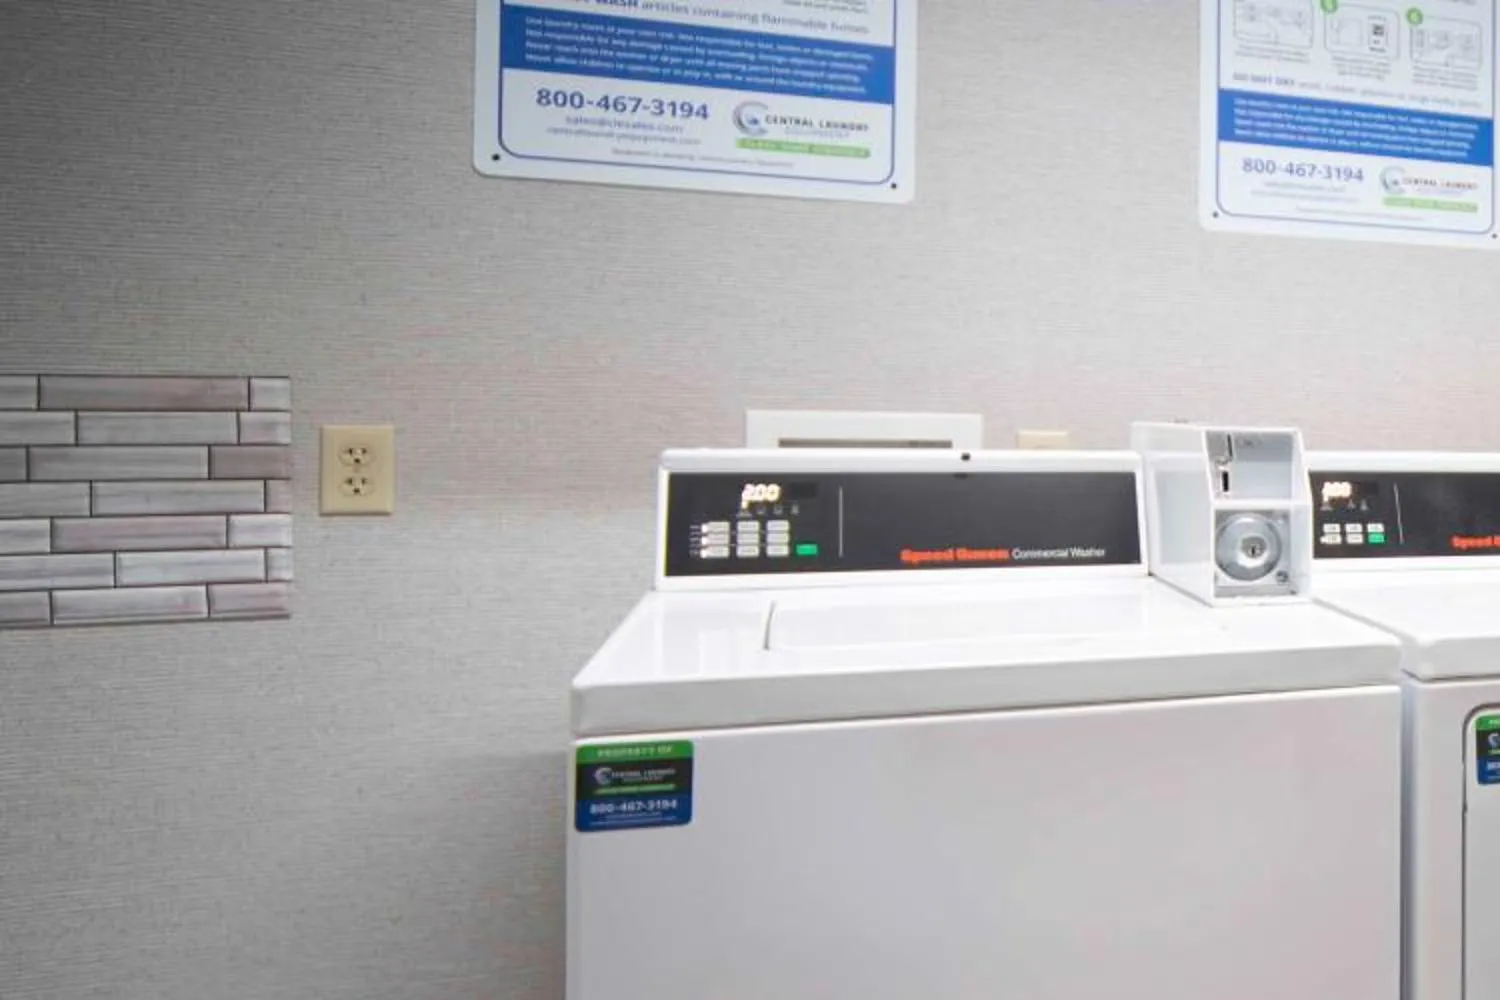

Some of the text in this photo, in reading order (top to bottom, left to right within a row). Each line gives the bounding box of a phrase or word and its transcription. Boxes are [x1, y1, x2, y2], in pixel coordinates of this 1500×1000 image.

[536, 87, 709, 120] 800-467-3194
[765, 114, 814, 128] CENTRAL
[1242, 157, 1364, 182] 800-467-3194
[901, 548, 954, 564] Speed
[1012, 548, 1069, 560] Commercial
[1070, 547, 1106, 558] Washer
